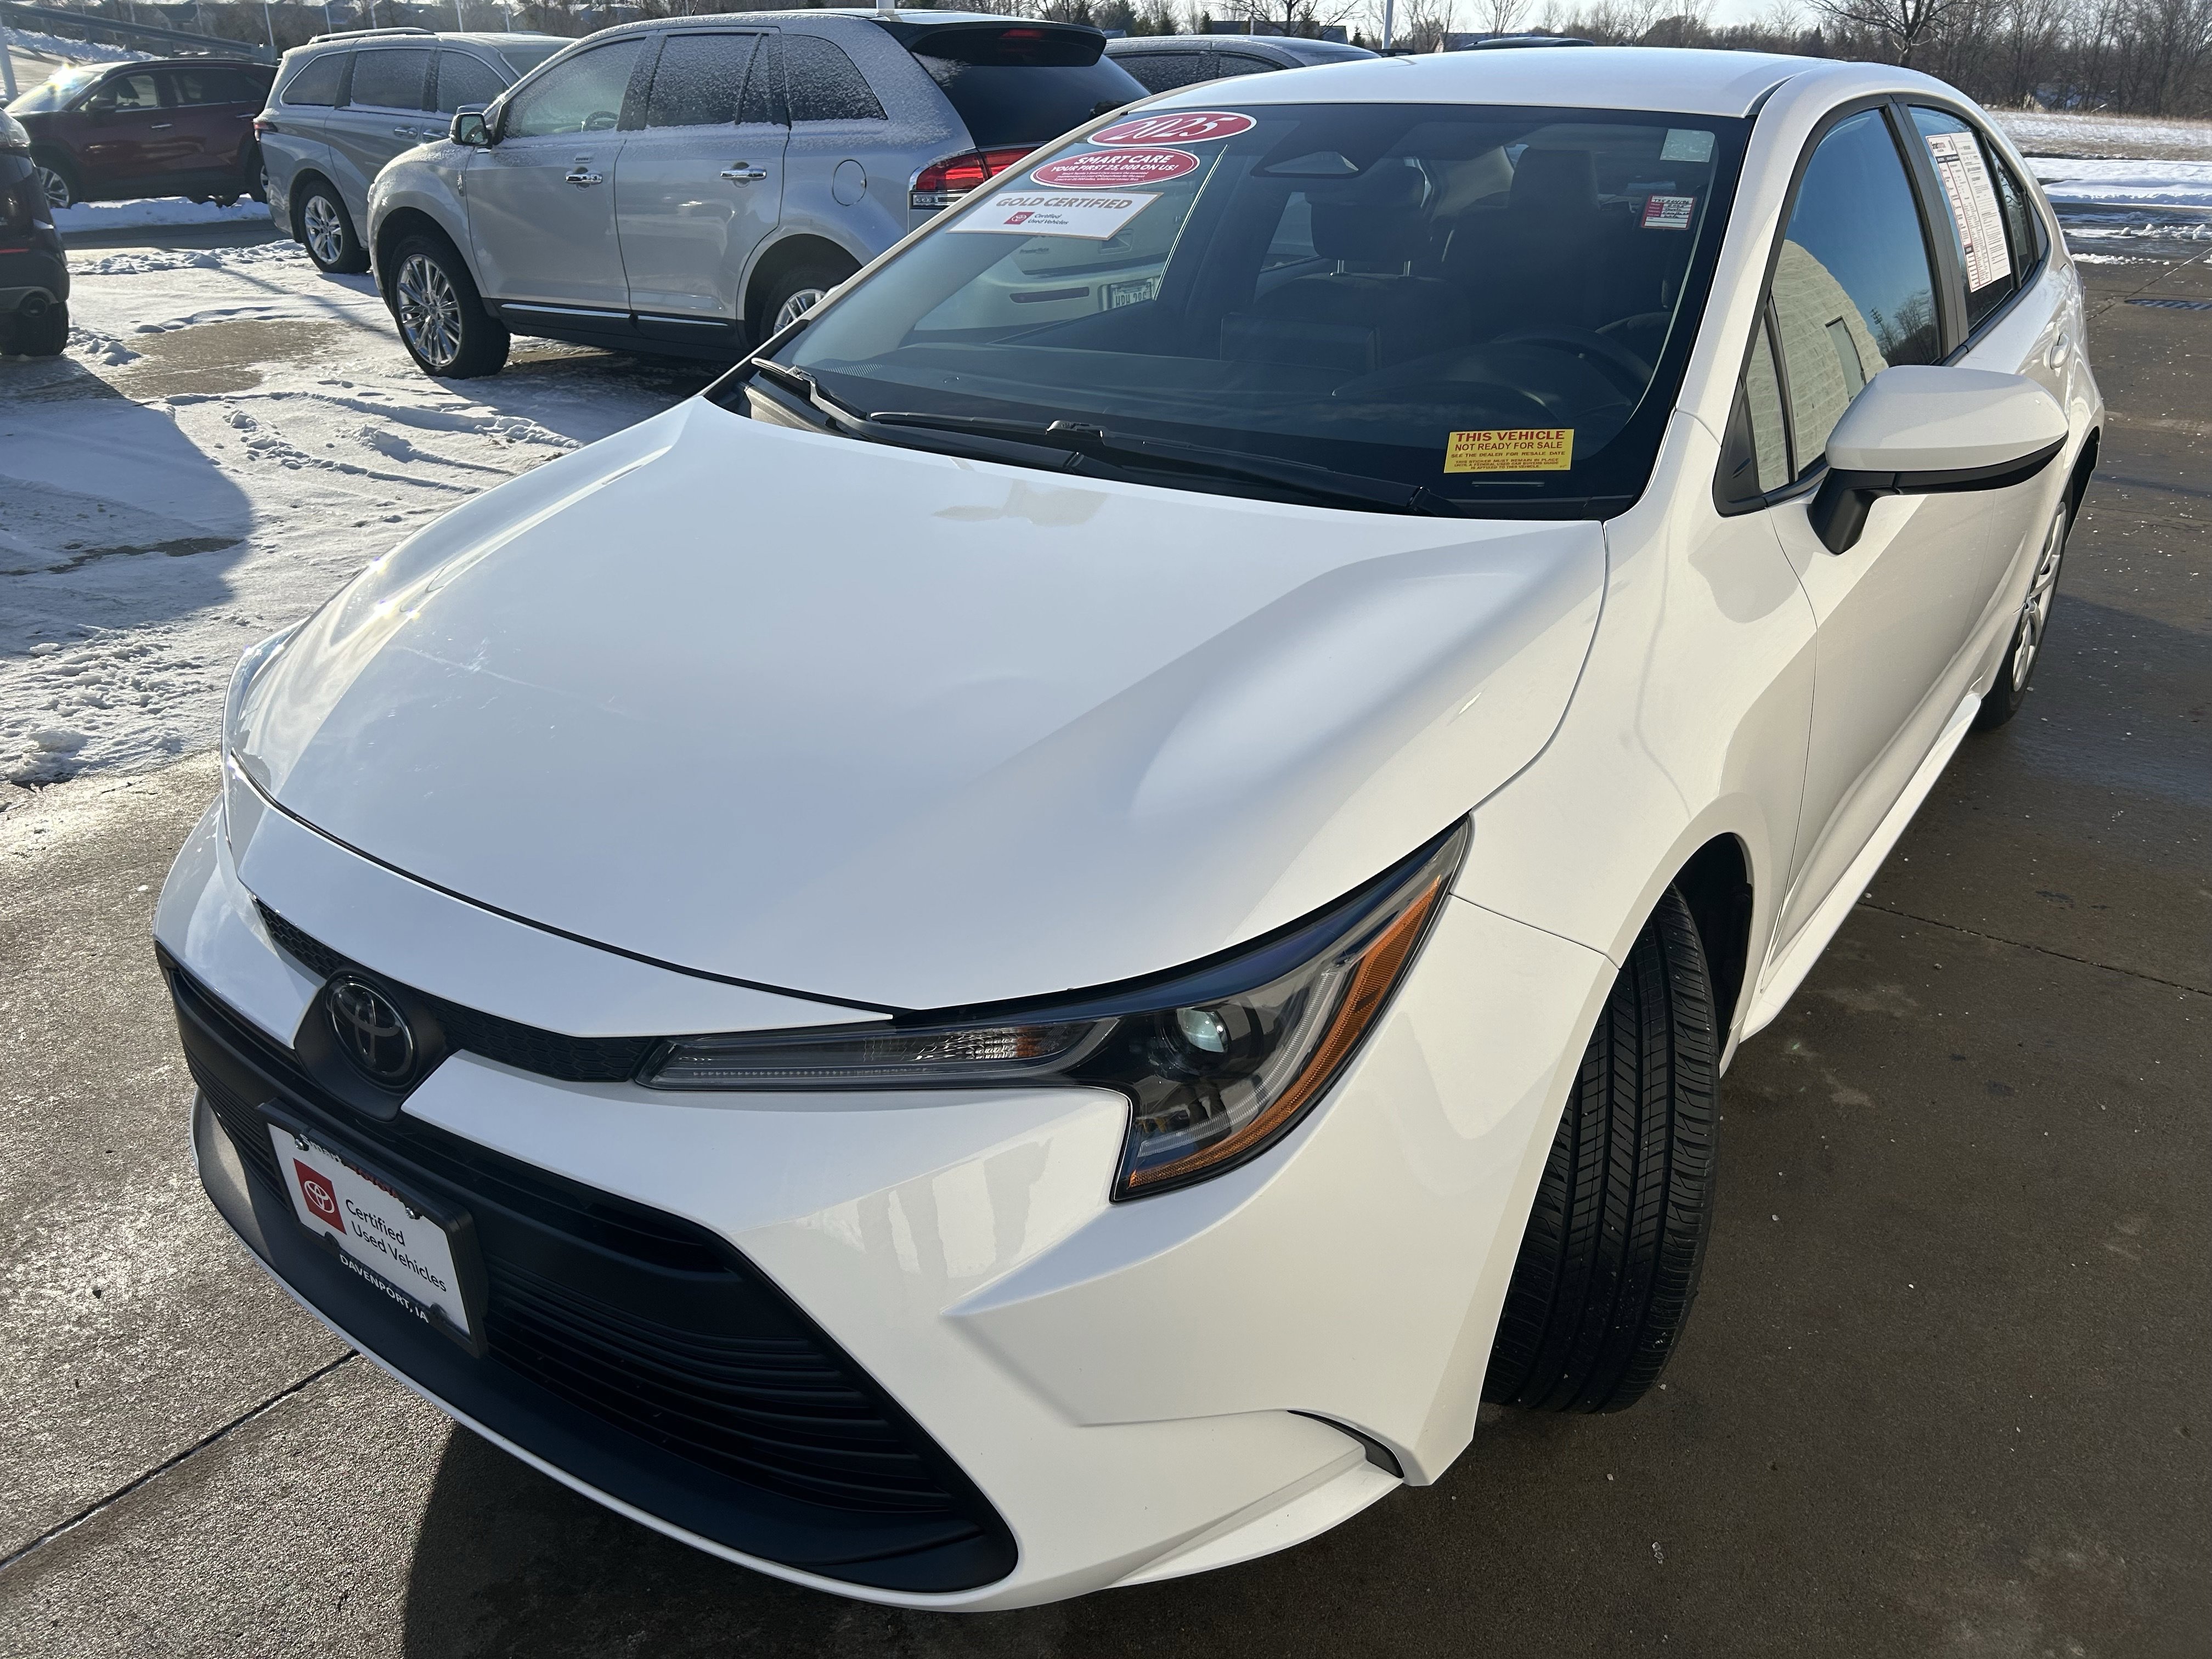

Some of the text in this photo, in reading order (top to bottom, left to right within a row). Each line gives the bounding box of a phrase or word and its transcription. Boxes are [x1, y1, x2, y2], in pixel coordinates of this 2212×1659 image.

[1103, 116, 1239, 141] 2025
[1074, 155, 1175, 165] SMART CARE
[996, 198, 1132, 209] GOLD CERTIFIED
[1456, 431, 1566, 442] THIS VEHICLE
[346, 1199, 406, 1247] Certified
[351, 1221, 447, 1292] Used Vehicles
[340, 1254, 430, 1323] DAVENPORT, IA
